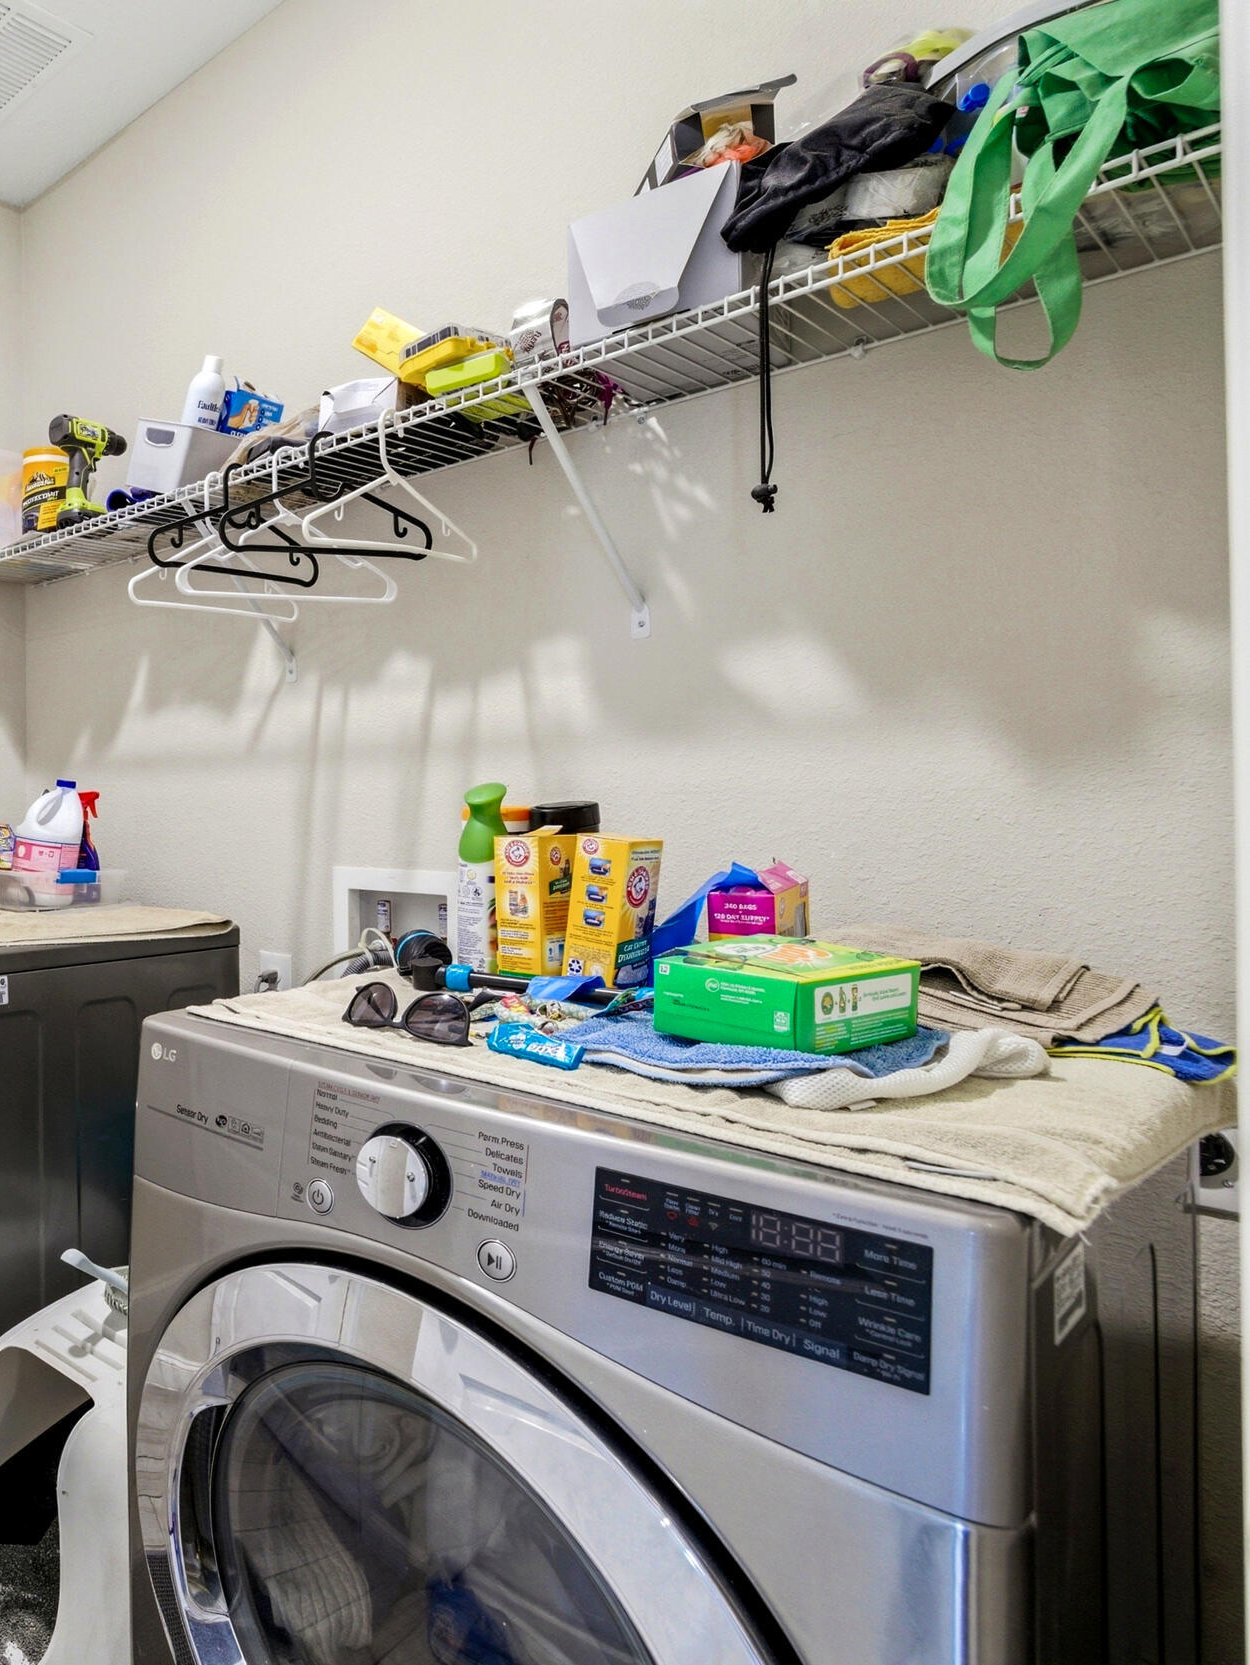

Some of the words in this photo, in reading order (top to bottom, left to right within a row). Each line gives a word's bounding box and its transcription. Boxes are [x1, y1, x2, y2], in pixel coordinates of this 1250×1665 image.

[163, 1050, 177, 1062] LG
[317, 1089, 338, 1100] Normal
[176, 1104, 196, 1119] Sensor
[197, 1111, 209, 1125] Dry
[316, 1101, 334, 1113] Heavy
[334, 1107, 350, 1118] Duty
[314, 1114, 338, 1129] Bedding
[501, 1137, 524, 1151] Press
[485, 1147, 524, 1165] Delicates
[492, 1163, 523, 1179] Towels
[478, 1179, 504, 1194] Speed
[505, 1187, 521, 1200] Dry
[490, 1199, 503, 1210] Air
[504, 1203, 521, 1217] Dry
[467, 1208, 520, 1232] Downloaded
[599, 1210, 626, 1224] Reduce
[626, 1217, 648, 1230] Static
[669, 1231, 686, 1243] Very
[668, 1242, 686, 1254] More
[711, 1243, 730, 1255] High
[863, 1249, 890, 1265] More
[892, 1256, 918, 1271] Time
[598, 1271, 626, 1287] Custom
[710, 1265, 741, 1281] Medium
[666, 1276, 687, 1289] Damp
[710, 1278, 728, 1289] Low
[650, 1290, 666, 1305] Dry
[667, 1297, 692, 1313] Level
[809, 1295, 829, 1307] High
[864, 1286, 890, 1300] Less
[891, 1292, 916, 1307] Time
[703, 1306, 736, 1329] Temp.
[808, 1307, 828, 1319] Low
[808, 1319, 822, 1329] Off
[857, 1316, 896, 1335] Wrinkle
[897, 1328, 922, 1343] Care
[745, 1320, 771, 1337] Time
[771, 1328, 791, 1346] Dry
[802, 1339, 841, 1360] Signal
[853, 1351, 879, 1368] Damp
[879, 1359, 896, 1373] Dry
[896, 1365, 926, 1380] Signal
